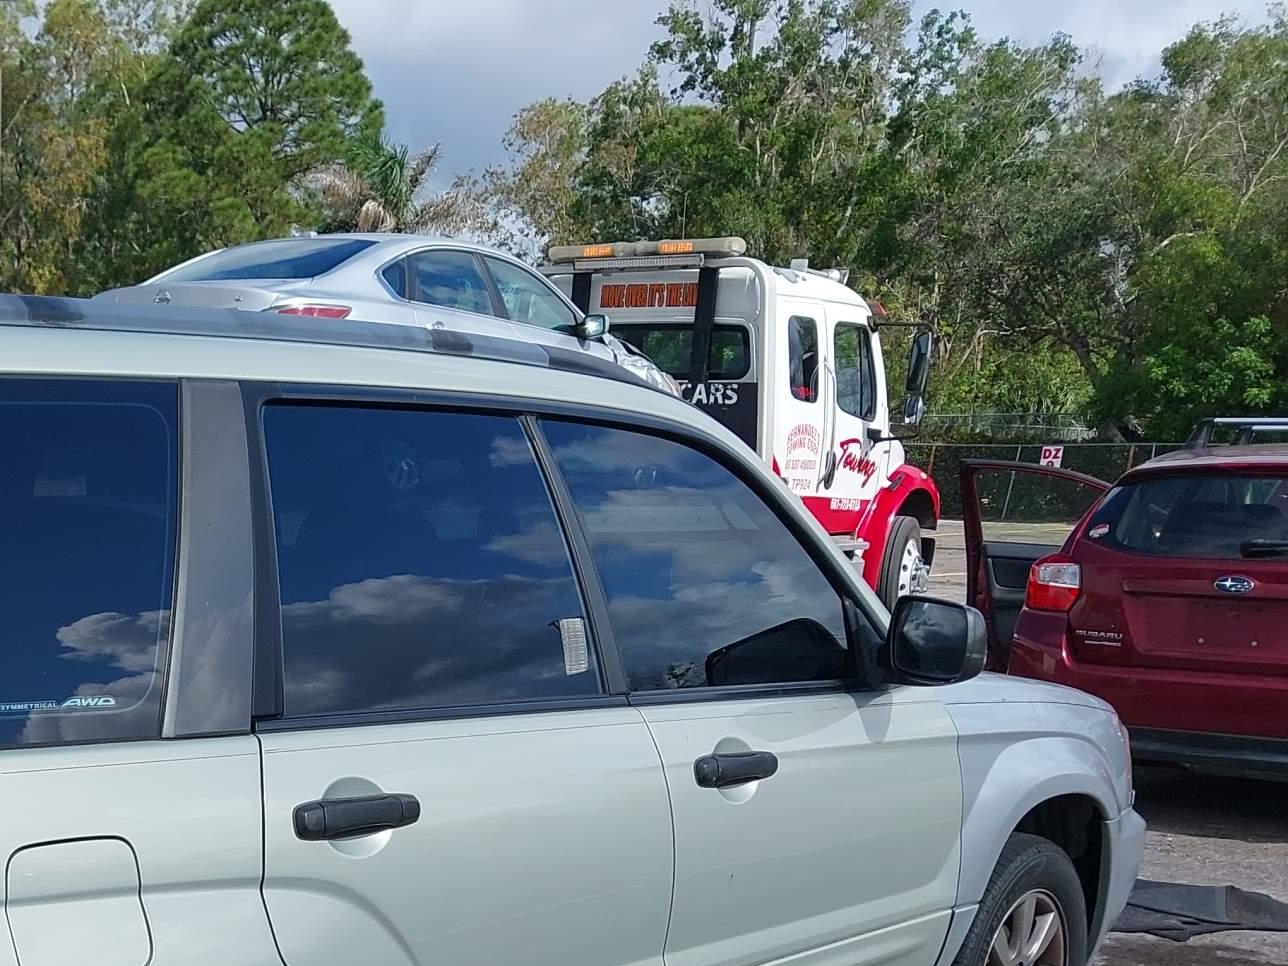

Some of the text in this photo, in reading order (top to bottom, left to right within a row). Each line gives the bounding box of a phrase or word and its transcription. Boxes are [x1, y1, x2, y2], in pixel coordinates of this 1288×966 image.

[600, 285, 625, 308] MOVE
[625, 284, 648, 308] OVER
[648, 283, 665, 307] IT'S
[665, 283, 682, 307] THE
[680, 384, 738, 405] CARS
[837, 438, 878, 488] Towing
[1043, 448, 1062, 459] DZ
[0, 697, 116, 711] SYMMETRICAL AWD
